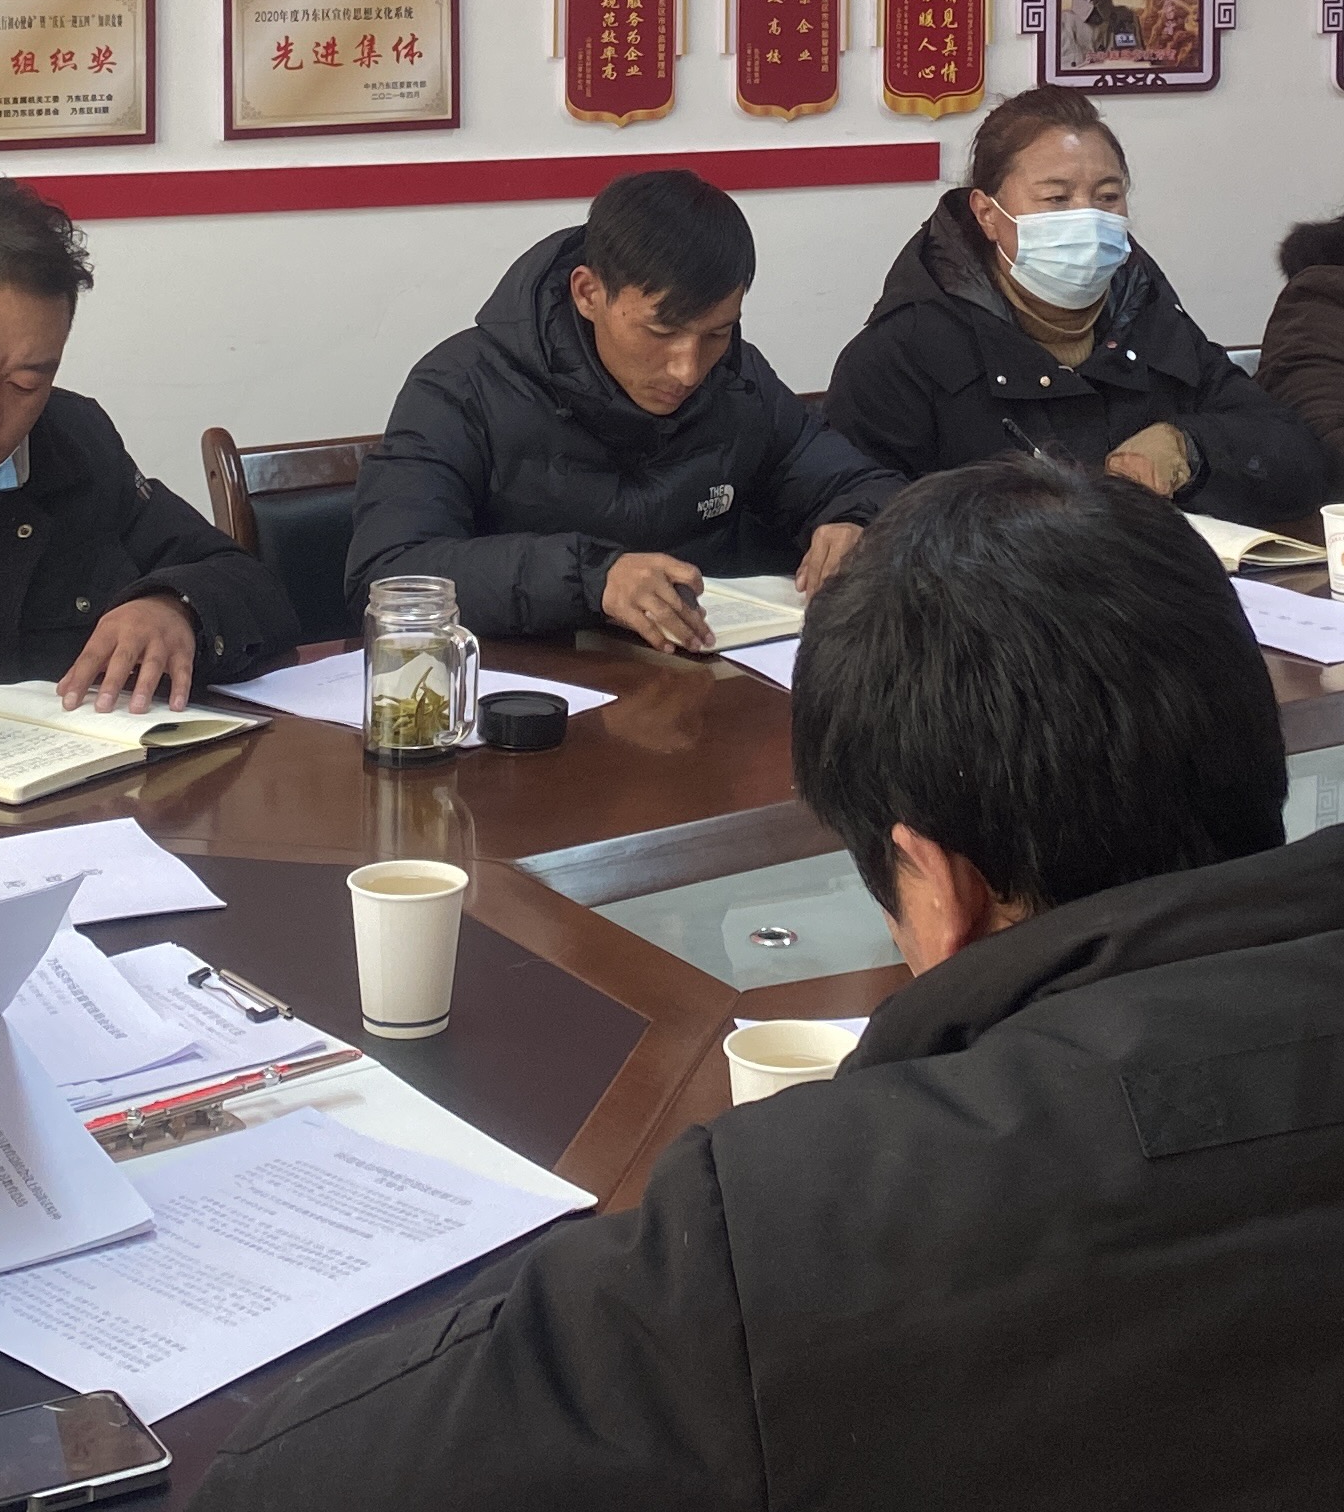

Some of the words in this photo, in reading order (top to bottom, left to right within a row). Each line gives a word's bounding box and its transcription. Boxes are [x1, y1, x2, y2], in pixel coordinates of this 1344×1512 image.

[254, 6, 414, 23] 2020年度乃东区宣传思想文化系统
[271, 33, 423, 70] 先进集体
[709, 484, 725, 498] THE
